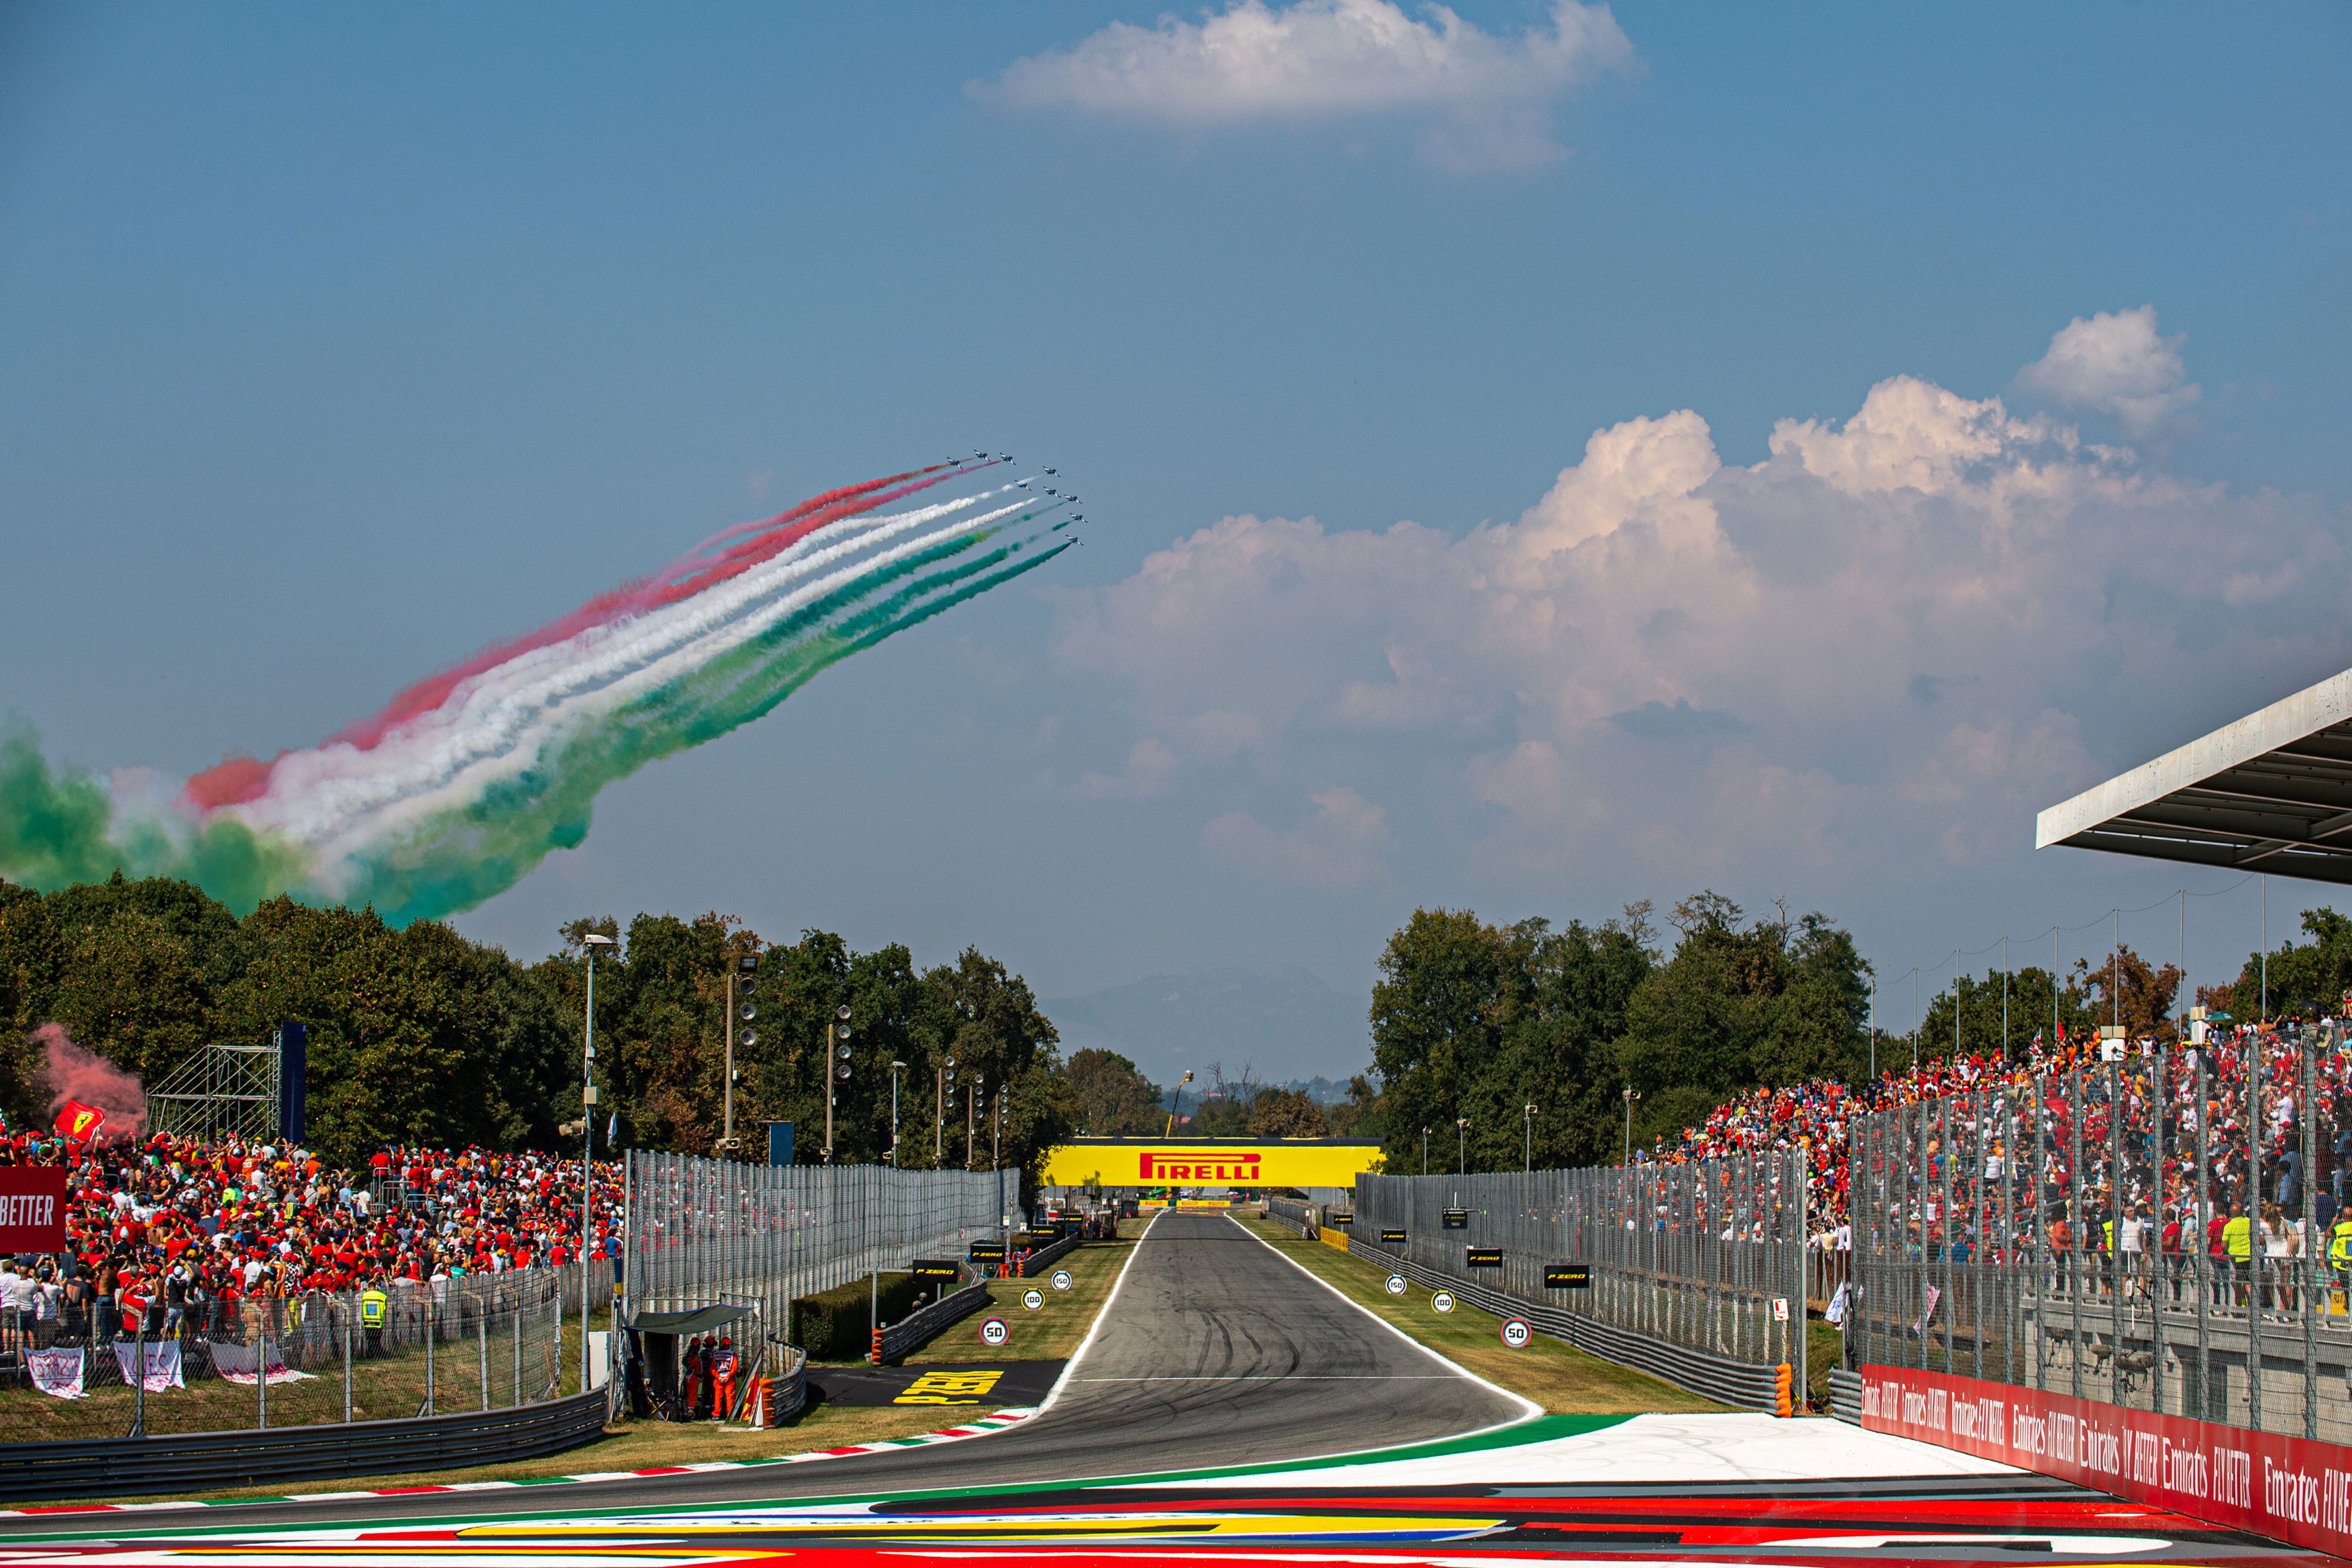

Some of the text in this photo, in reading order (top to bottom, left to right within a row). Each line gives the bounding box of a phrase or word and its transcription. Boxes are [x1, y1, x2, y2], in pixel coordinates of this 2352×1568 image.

[1140, 1152, 1261, 1179] PIRELLI
[0, 1195, 54, 1226] BETTER
[987, 1328, 1002, 1337] 50
[1508, 1328, 1524, 1338] 50
[1862, 1378, 1880, 1417] Emirats
[1978, 1398, 1988, 1441] FLY
[2047, 1410, 2056, 1457] FLY
[2056, 1412, 2074, 1463] BETTER
[2134, 1430, 2157, 1486] BETTER
[2213, 1446, 2226, 1502] FLY
[2226, 1448, 2251, 1509] BETTER
[2264, 1456, 2352, 1534] Emirates FLY BE
